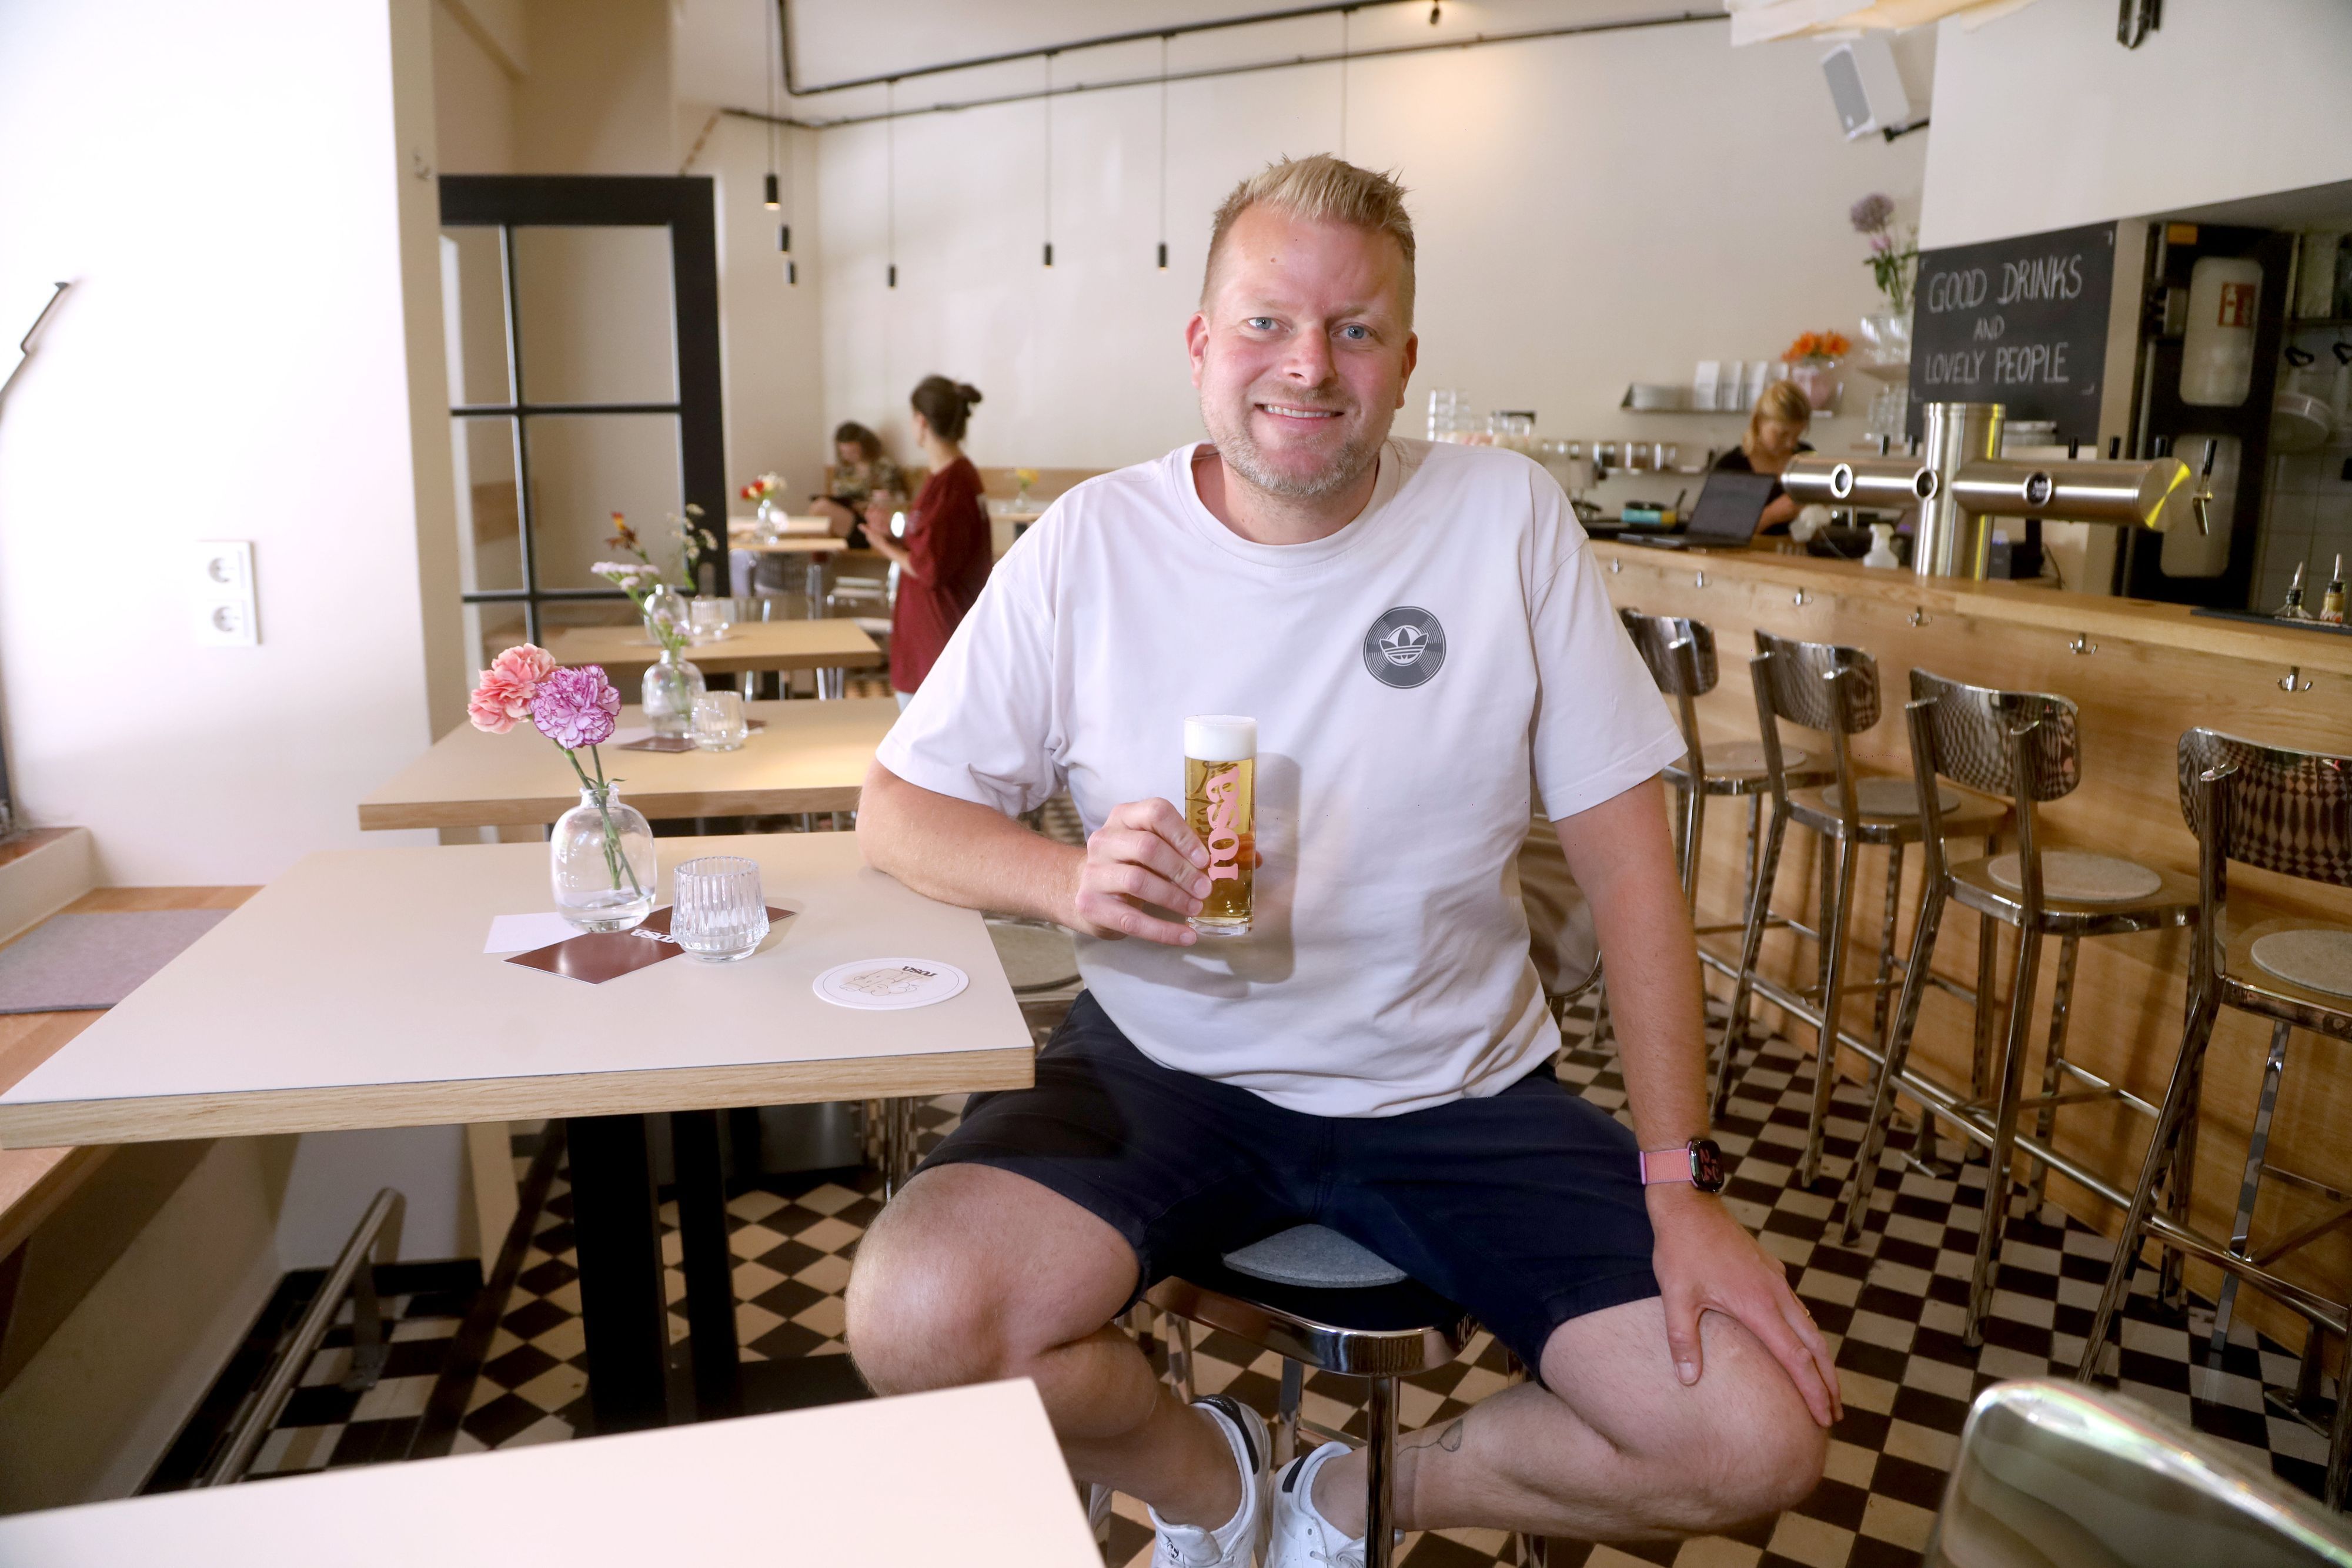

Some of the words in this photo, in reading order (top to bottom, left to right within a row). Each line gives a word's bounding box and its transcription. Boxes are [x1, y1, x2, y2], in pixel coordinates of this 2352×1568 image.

[1928, 268, 1987, 314] GOOD
[1997, 253, 2083, 306] DRINKS
[1973, 315, 2006, 342] AND
[1924, 348, 1987, 385] LOVELY
[1994, 341, 2070, 385] PEOPLE
[1206, 766, 1240, 881] rosa
